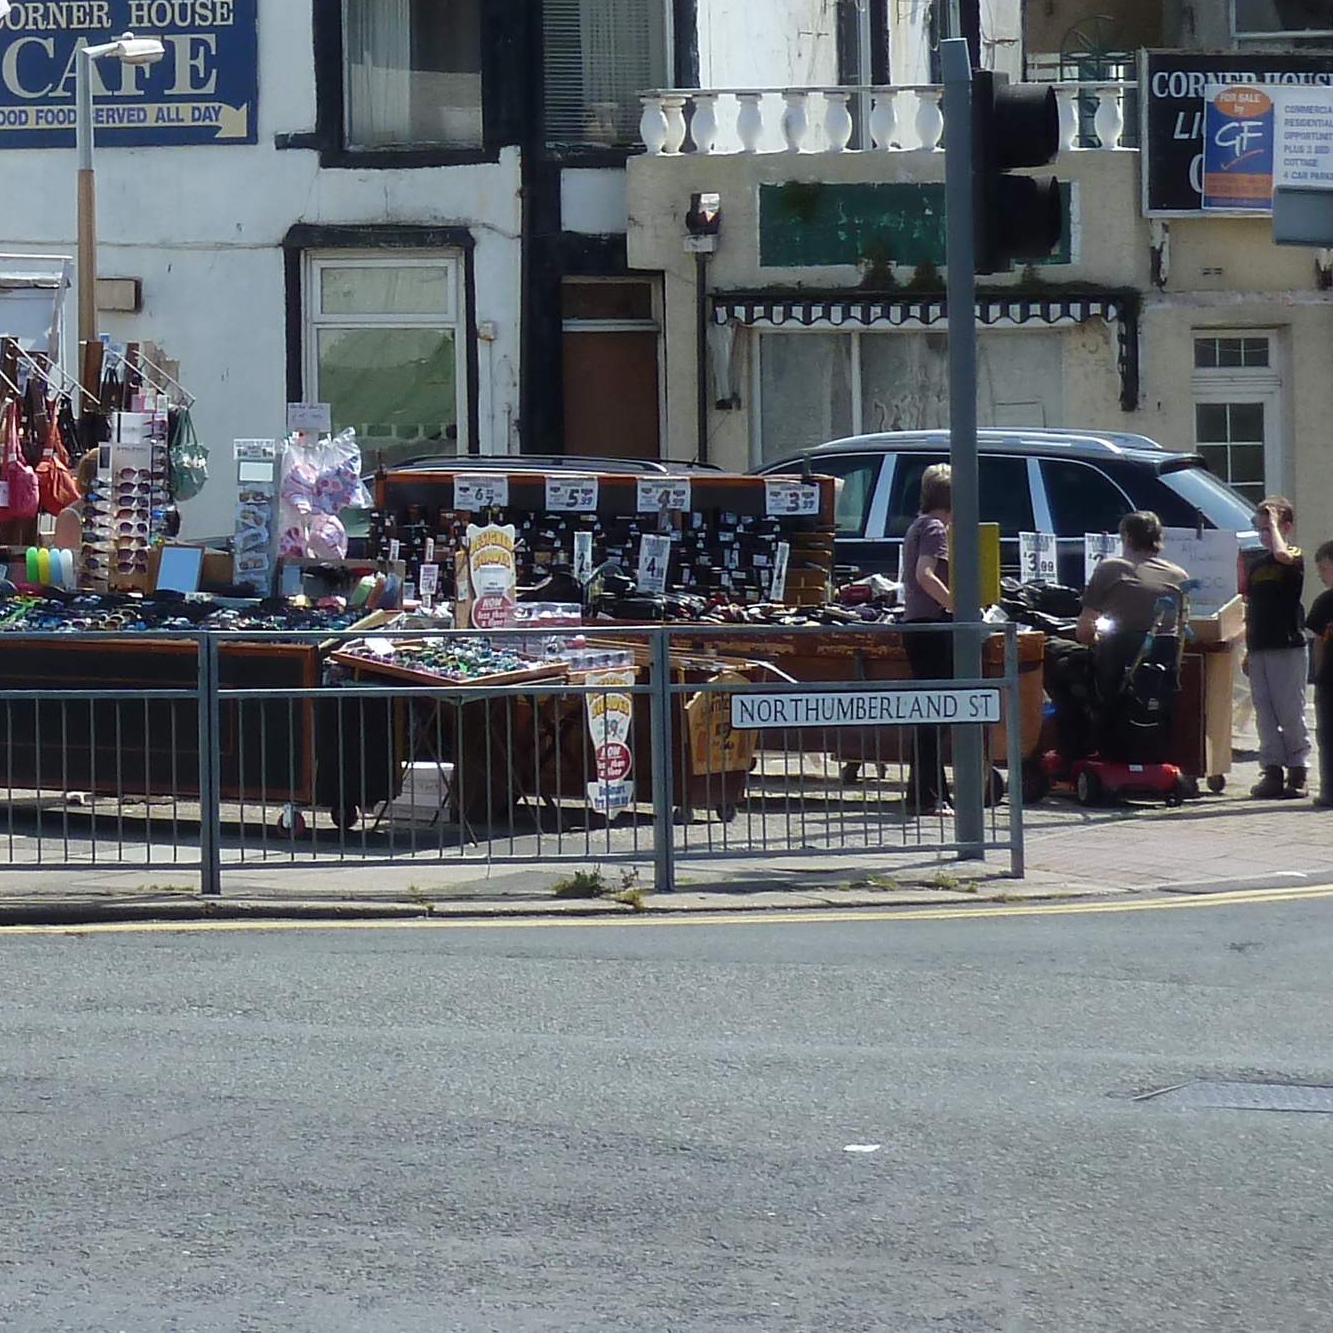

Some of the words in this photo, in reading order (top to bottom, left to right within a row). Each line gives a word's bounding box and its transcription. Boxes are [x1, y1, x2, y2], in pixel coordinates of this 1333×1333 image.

[2, 33, 217, 99] CAFE
[1219, 93, 1237, 102] FOR
[1239, 93, 1262, 103] SALE
[35, 108, 77, 126] FOOD
[91, 107, 147, 125] ERVED
[155, 107, 184, 123] ALL
[191, 105, 223, 123] DAY
[1284, 131, 1333, 140] OPPORTUNIT
[1291, 171, 1308, 180] CAR
[482, 598, 503, 609] NOW
[739, 694, 958, 724] NORTHUMBERLAND
[969, 694, 993, 717] ST
